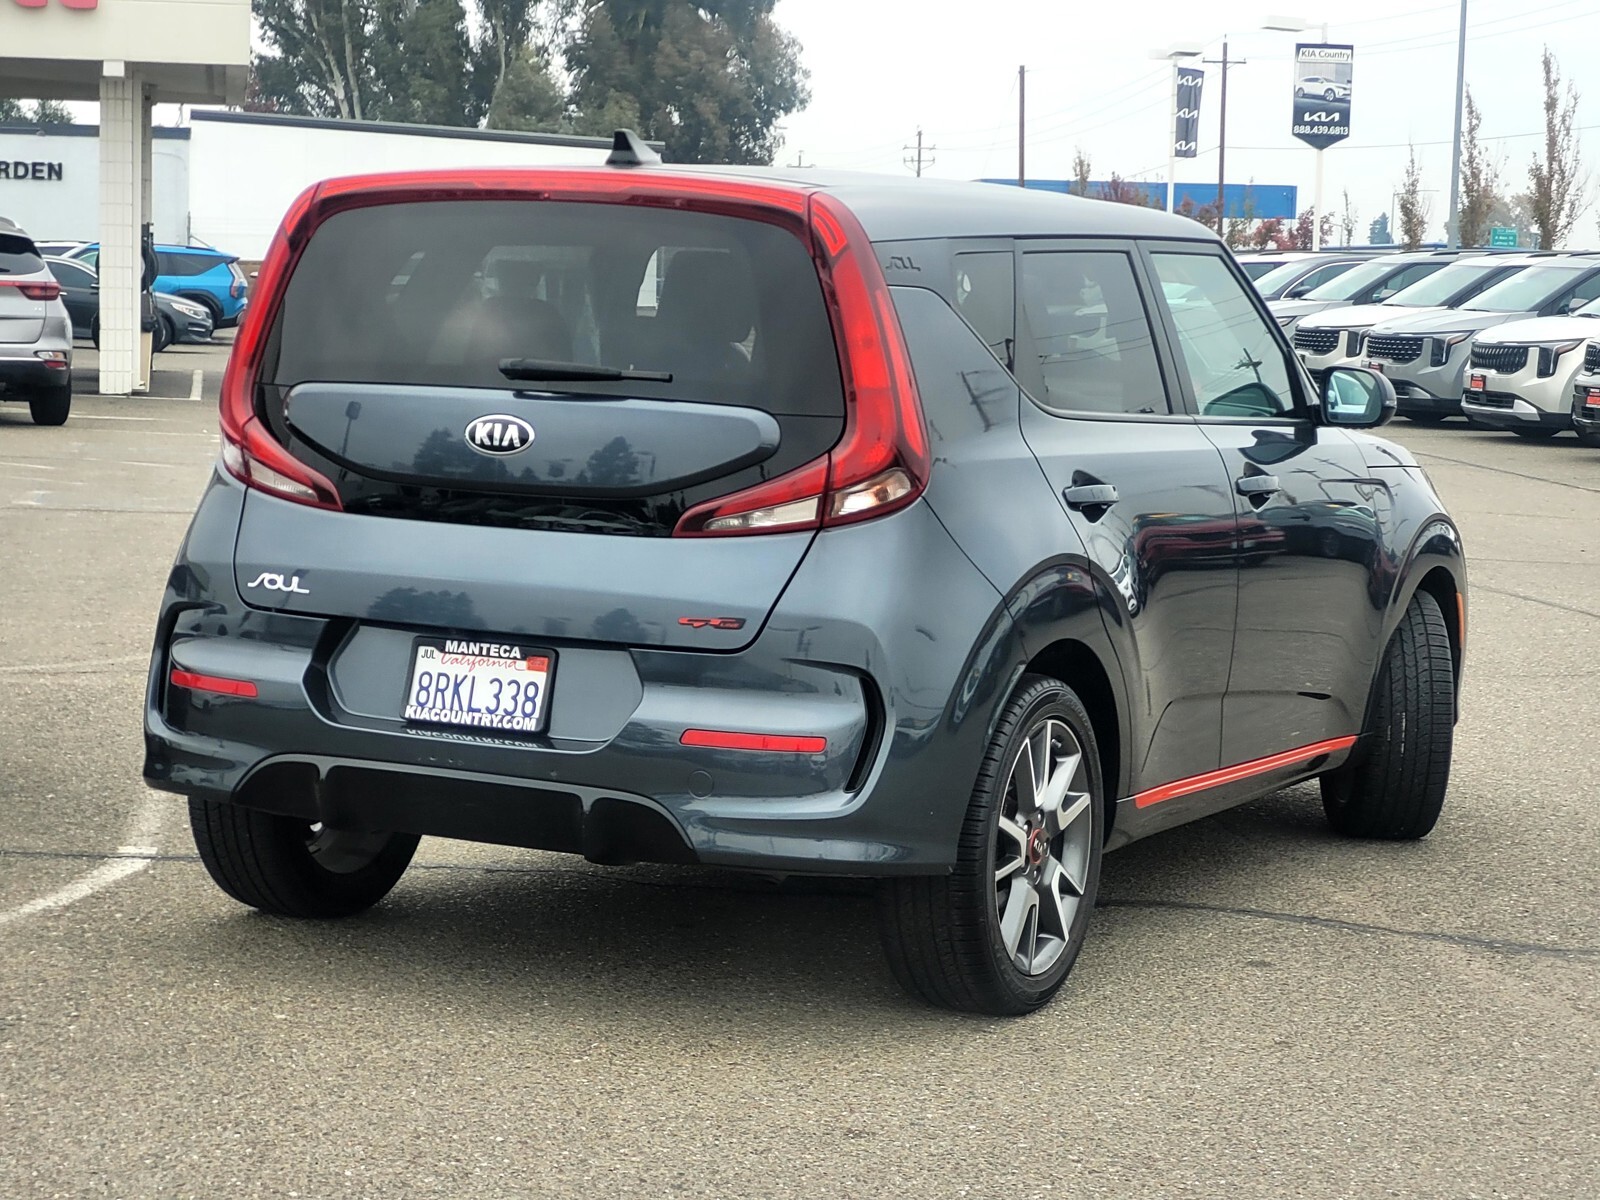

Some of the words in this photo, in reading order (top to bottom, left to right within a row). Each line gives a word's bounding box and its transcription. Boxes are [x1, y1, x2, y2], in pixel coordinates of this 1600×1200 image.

[1301, 50, 1317, 58] KIA
[1319, 50, 1350, 60] Country
[1294, 125, 1348, 135] 888.439.6813
[0, 161, 63, 181] RDEN
[475, 422, 521, 447] KIA
[421, 648, 436, 659] JUL
[445, 640, 521, 659] MANTECA
[441, 652, 526, 672] California
[415, 671, 539, 717] 8RKL338
[405, 705, 537, 731] KIACOUNTRY.COM
